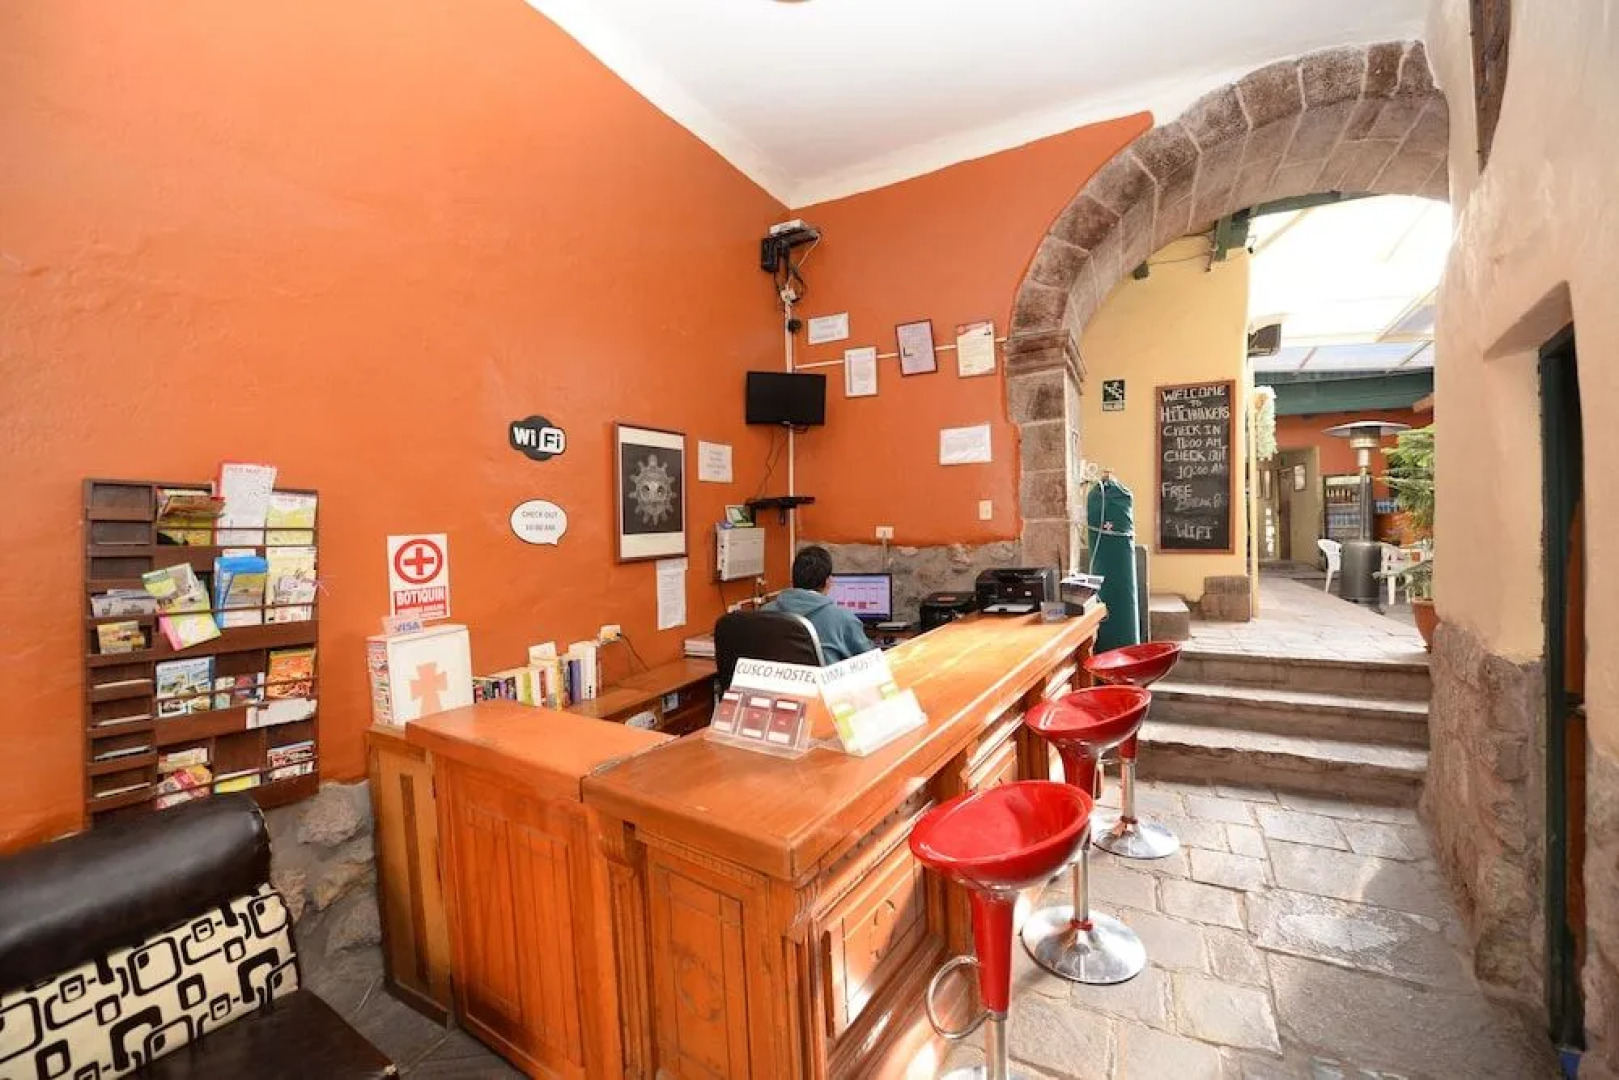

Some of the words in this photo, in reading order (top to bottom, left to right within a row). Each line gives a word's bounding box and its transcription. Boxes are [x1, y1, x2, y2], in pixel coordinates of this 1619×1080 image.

[1162, 386, 1225, 402] WELCOME
[1163, 424, 1202, 437] CHECK
[1204, 425, 1221, 435] IN
[1206, 437, 1221, 449] AM
[1164, 450, 1207, 462] CHECK
[1208, 446, 1227, 461] OUT
[1162, 482, 1192, 499] FREE
[521, 510, 543, 518] CHECK
[396, 586, 445, 606] BOTIQUIN
[394, 621, 420, 632] VISA
[736, 661, 774, 679] CUSCO
[775, 667, 818, 685] HOSTEL
